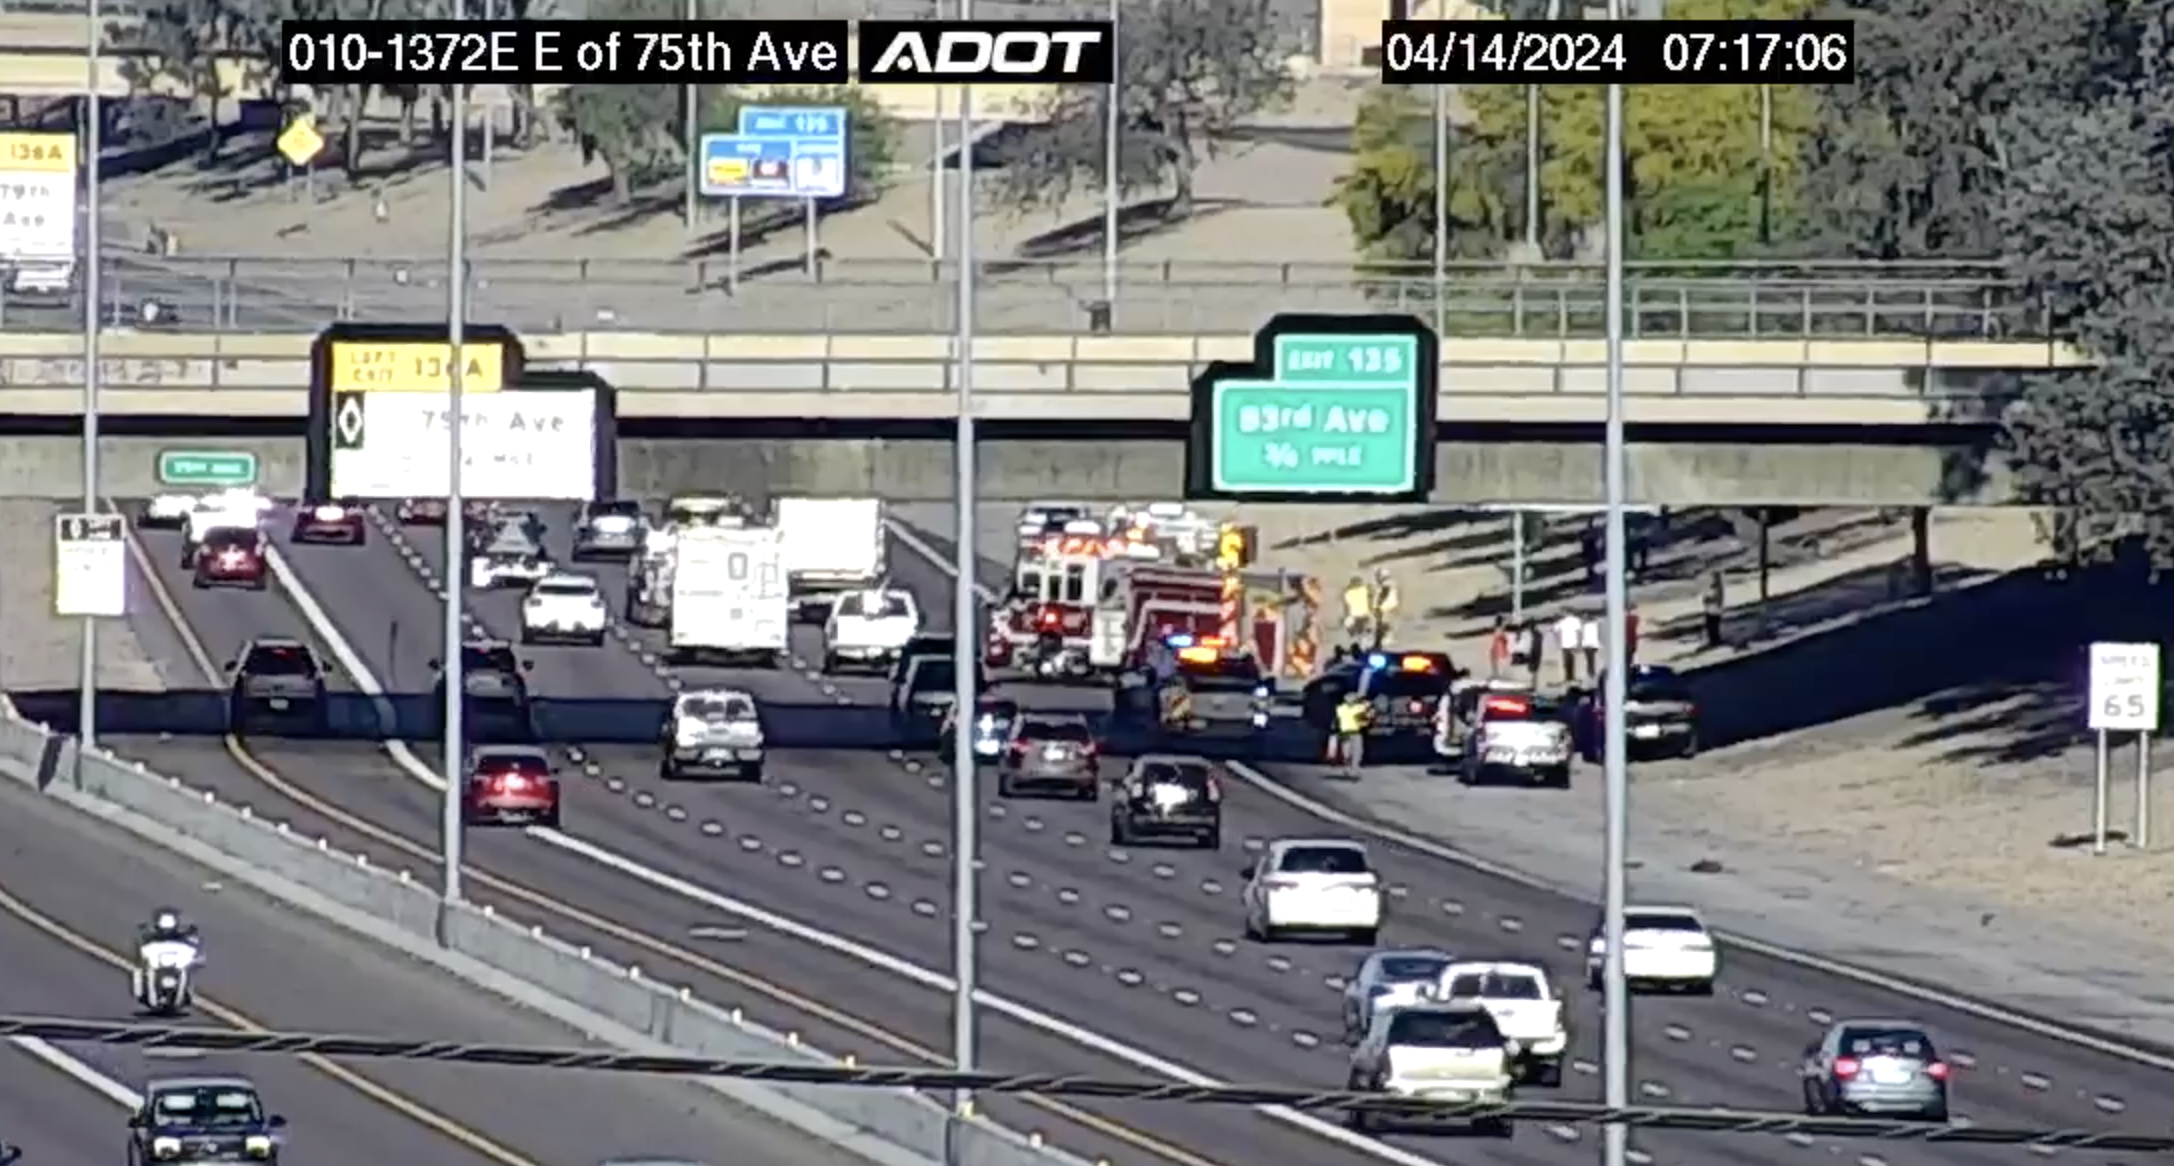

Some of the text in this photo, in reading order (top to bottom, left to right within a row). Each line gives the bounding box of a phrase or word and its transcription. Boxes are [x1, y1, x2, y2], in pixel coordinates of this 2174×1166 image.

[508, 411, 565, 433] Ave
[1323, 405, 1389, 433] Ave
[2103, 693, 2146, 717] 65
